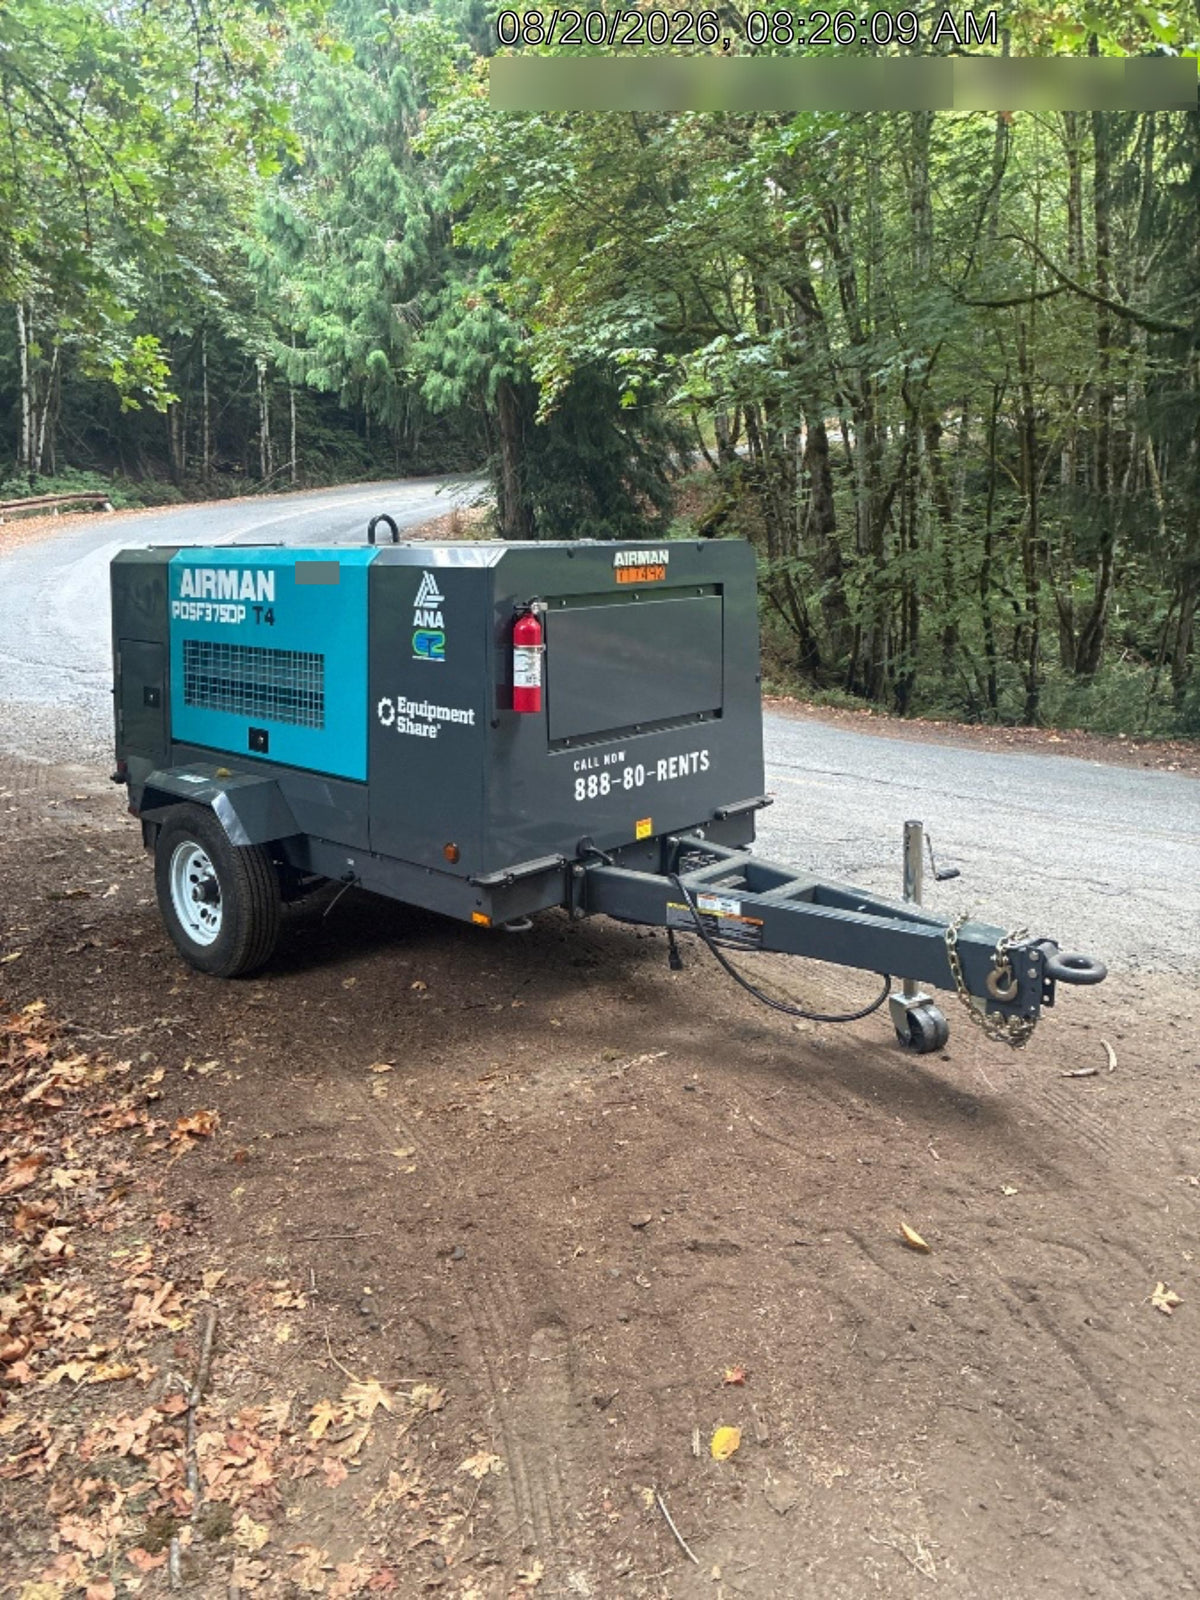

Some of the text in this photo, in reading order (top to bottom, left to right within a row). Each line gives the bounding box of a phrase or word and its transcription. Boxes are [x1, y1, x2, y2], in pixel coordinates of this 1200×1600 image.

[613, 549, 670, 567] AIRMAN
[180, 568, 275, 602] AIRMAN
[252, 605, 276, 627] T4
[413, 609, 445, 629] ANA
[397, 696, 475, 726] Equipment
[573, 750, 626, 772] CALL NOW
[574, 749, 710, 801] 888-80-RENTS
